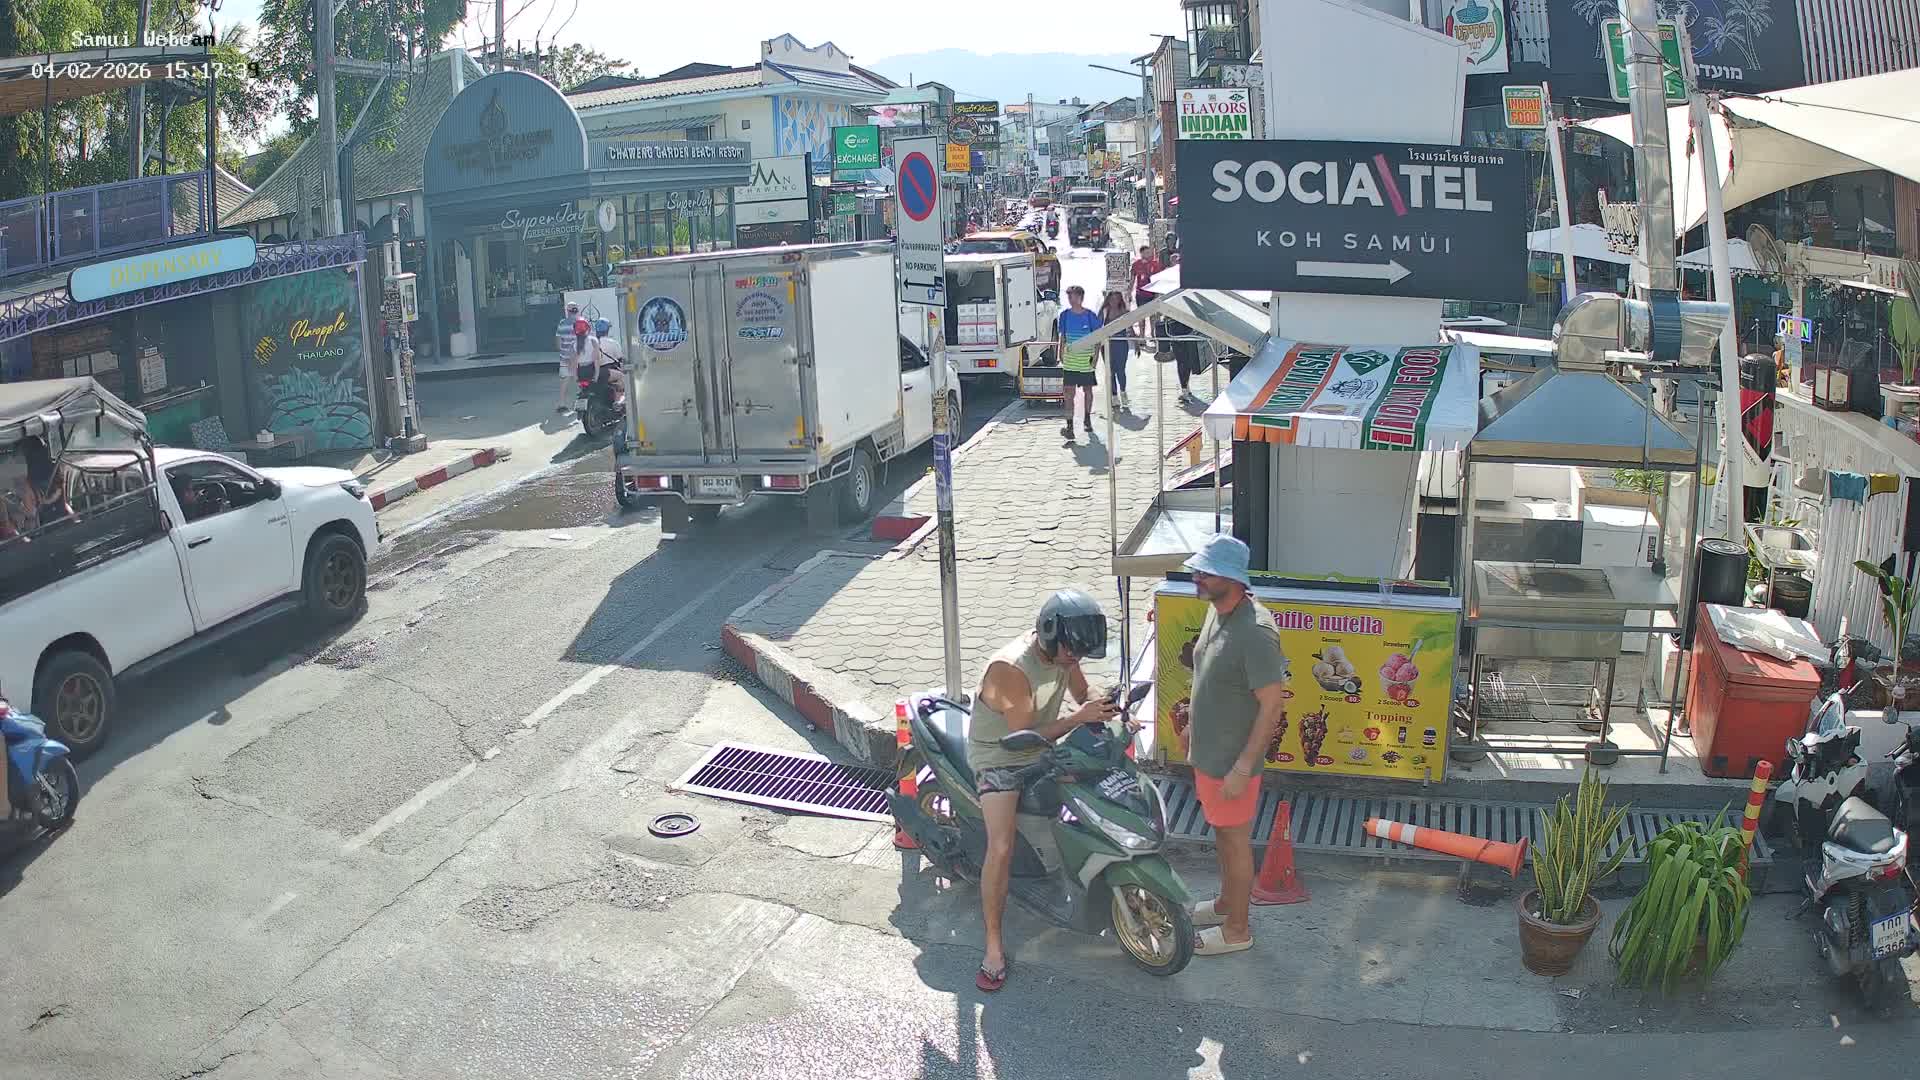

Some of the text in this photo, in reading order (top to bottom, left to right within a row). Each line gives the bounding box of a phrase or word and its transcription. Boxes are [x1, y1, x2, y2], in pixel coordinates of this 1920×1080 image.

[1182, 102, 1247, 115] FLAVORS
[1508, 98, 1540, 110] INDIAN
[1181, 114, 1248, 132] INDIAN
[1510, 111, 1540, 124] FOOD
[608, 145, 745, 160] CHAWENG GARDEN BEACH RESORT
[837, 153, 878, 164] EXCHANGE
[1256, 230, 1451, 254] KOH SAMUI
[111, 247, 224, 289] DISPENSARY
[905, 262, 937, 272] NO PARKING
[290, 312, 349, 348] Pineapple
[297, 348, 344, 361] THAILAND
[1369, 387, 1431, 447] INDIAN
[1271, 611, 1384, 635] affle nutella
[1366, 711, 1413, 724] Topping
